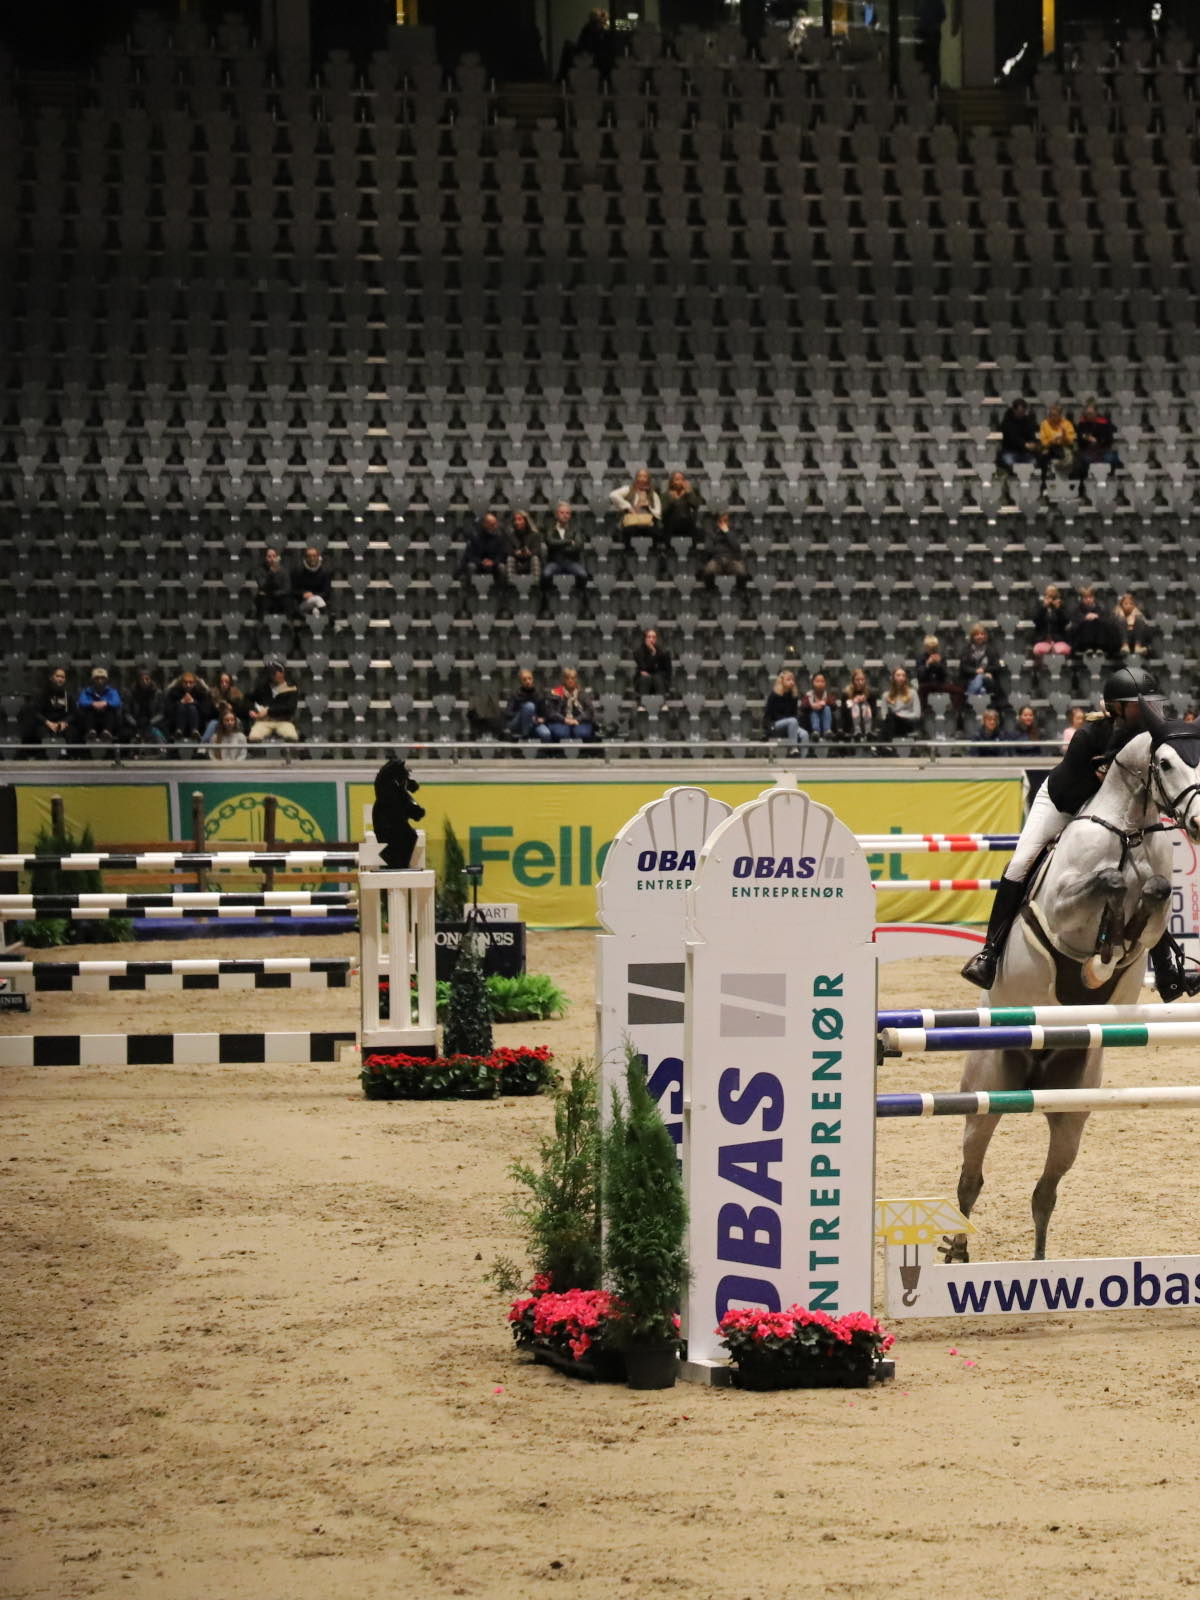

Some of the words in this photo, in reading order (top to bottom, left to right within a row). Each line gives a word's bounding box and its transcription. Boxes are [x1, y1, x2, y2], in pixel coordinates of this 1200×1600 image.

[469, 826, 614, 887] Fell
[637, 850, 697, 872] OBA
[733, 856, 816, 879] OBAS
[637, 879, 693, 890] ENTREP
[732, 887, 844, 898] ENTREPRENØR
[478, 907, 509, 919] ART
[808, 973, 844, 1311] NTREPRENØR
[716, 1067, 785, 1325] OBAS
